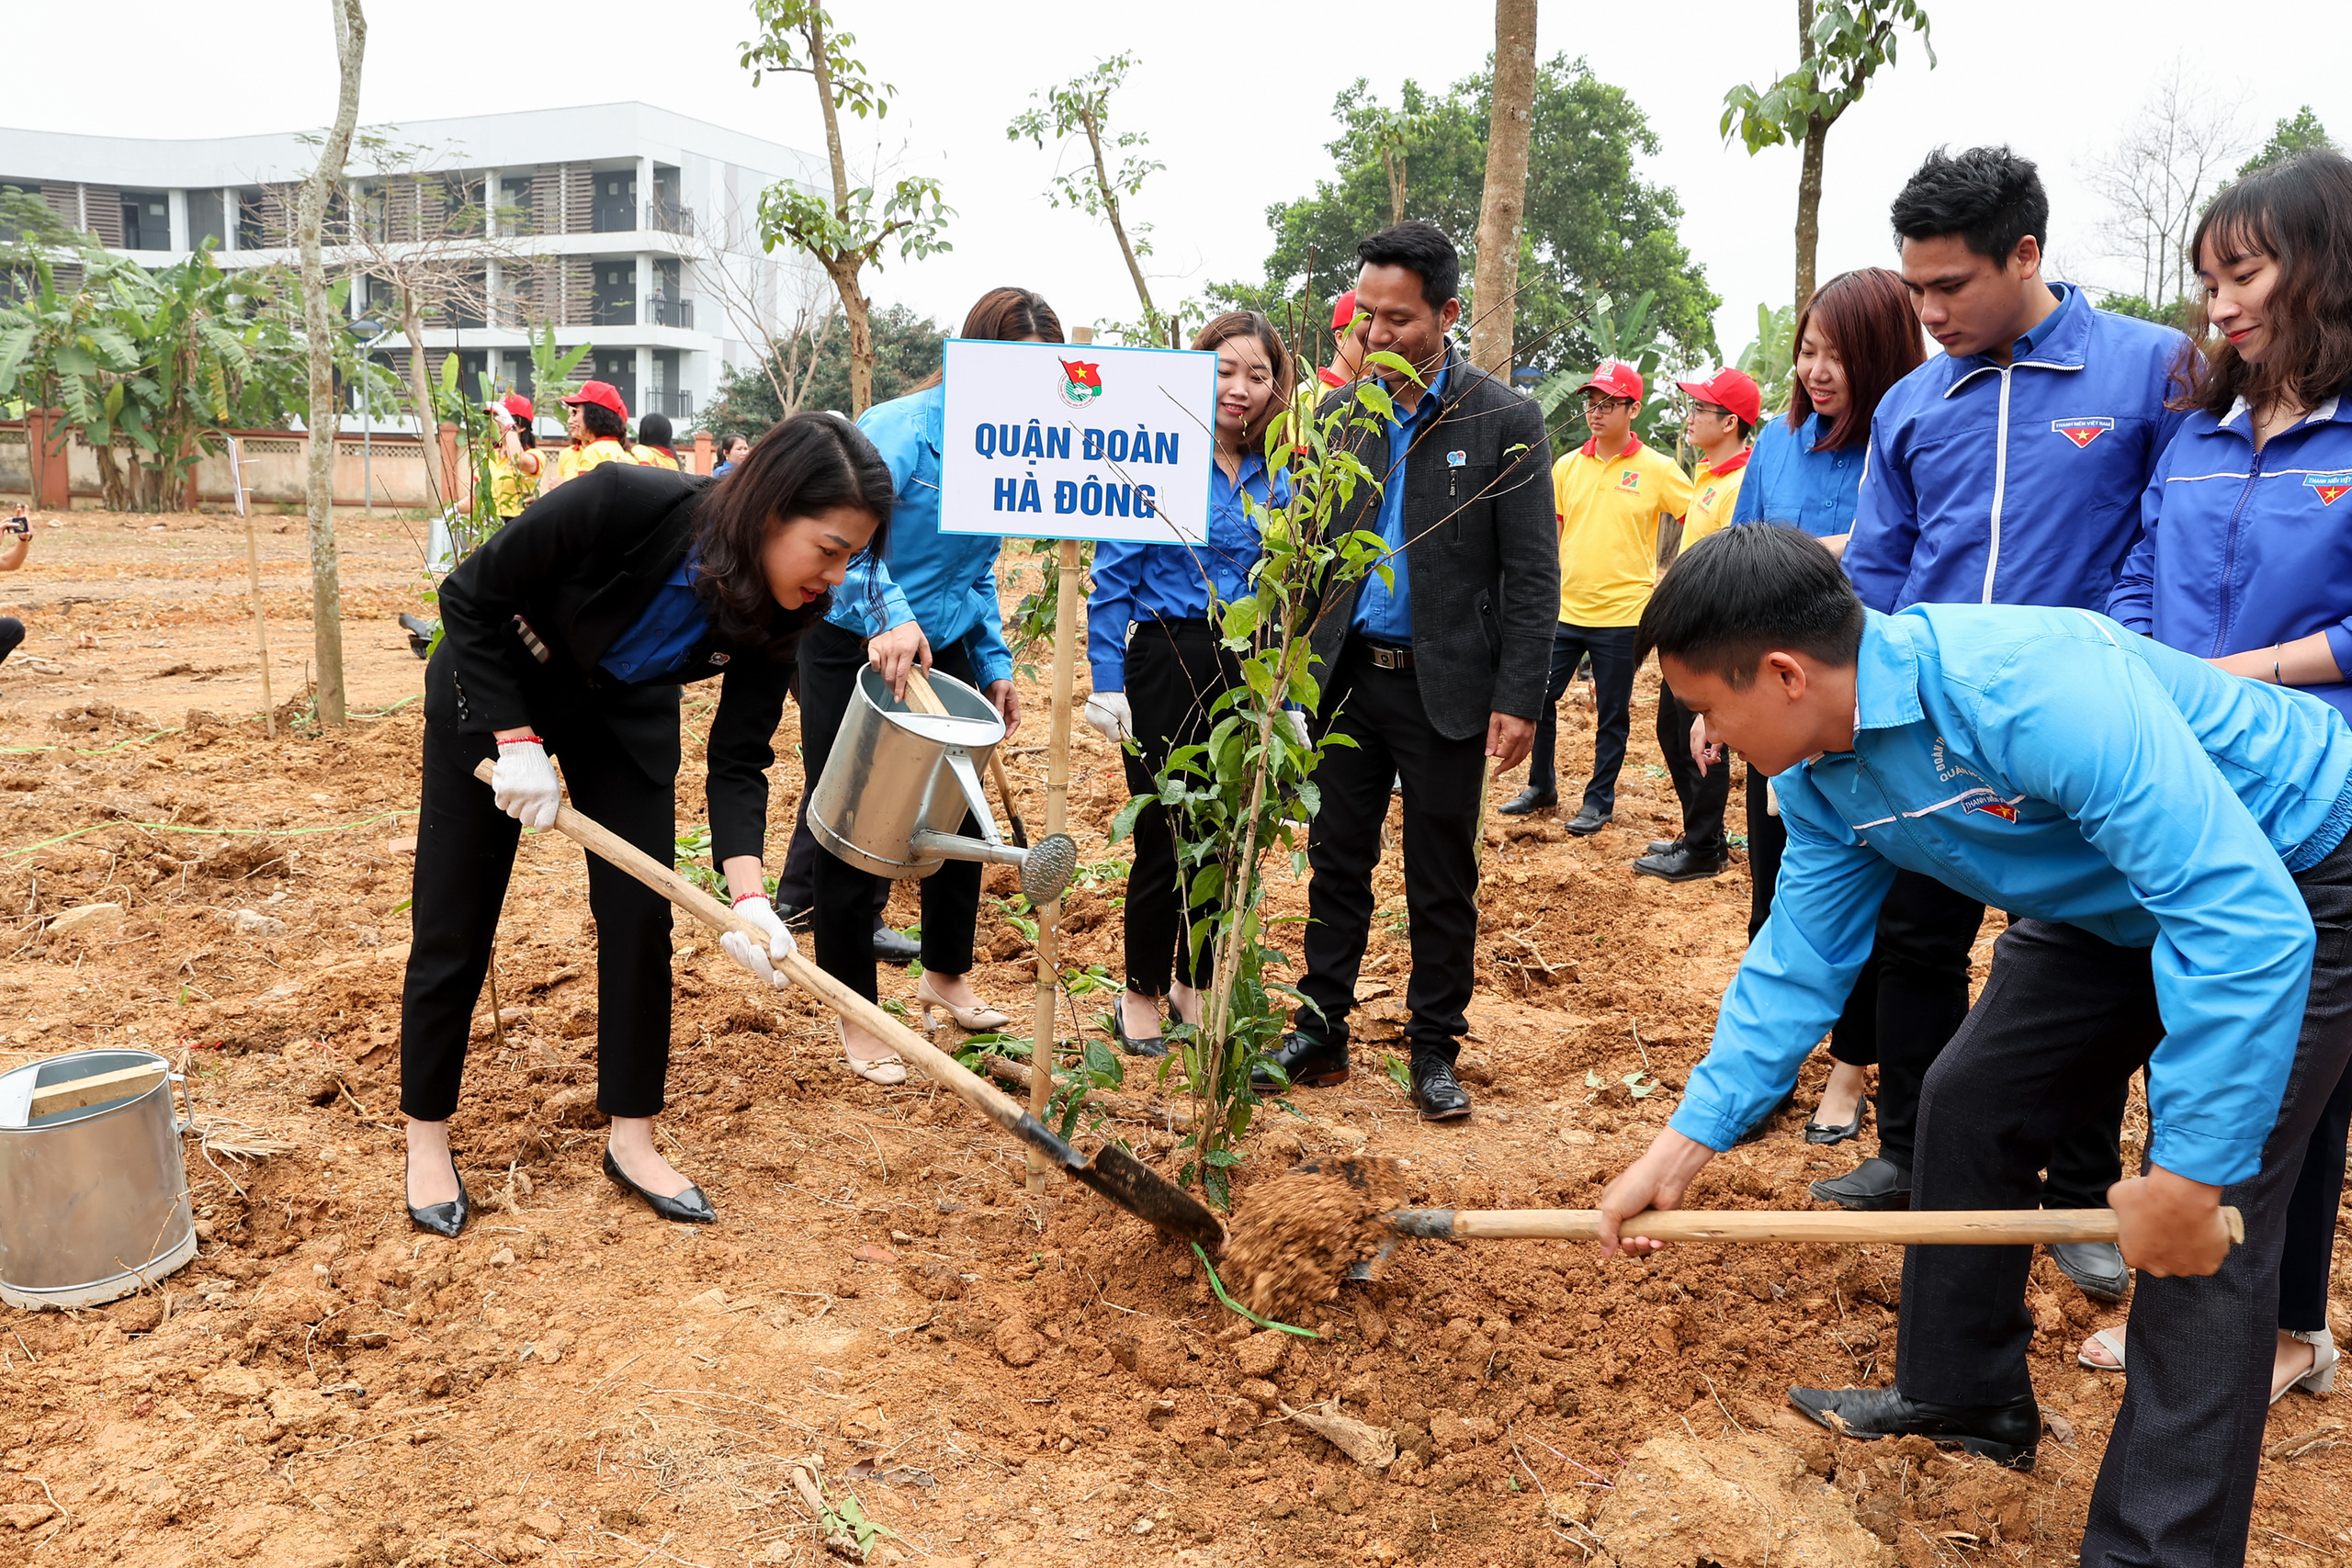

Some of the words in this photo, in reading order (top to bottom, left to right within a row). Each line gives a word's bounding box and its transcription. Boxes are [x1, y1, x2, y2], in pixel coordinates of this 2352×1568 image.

[975, 418, 1070, 465] QUẬN
[1082, 423, 1179, 465] ĐOÀN
[993, 471, 1042, 513] HÀ
[1054, 474, 1156, 519] ĐÔNG
